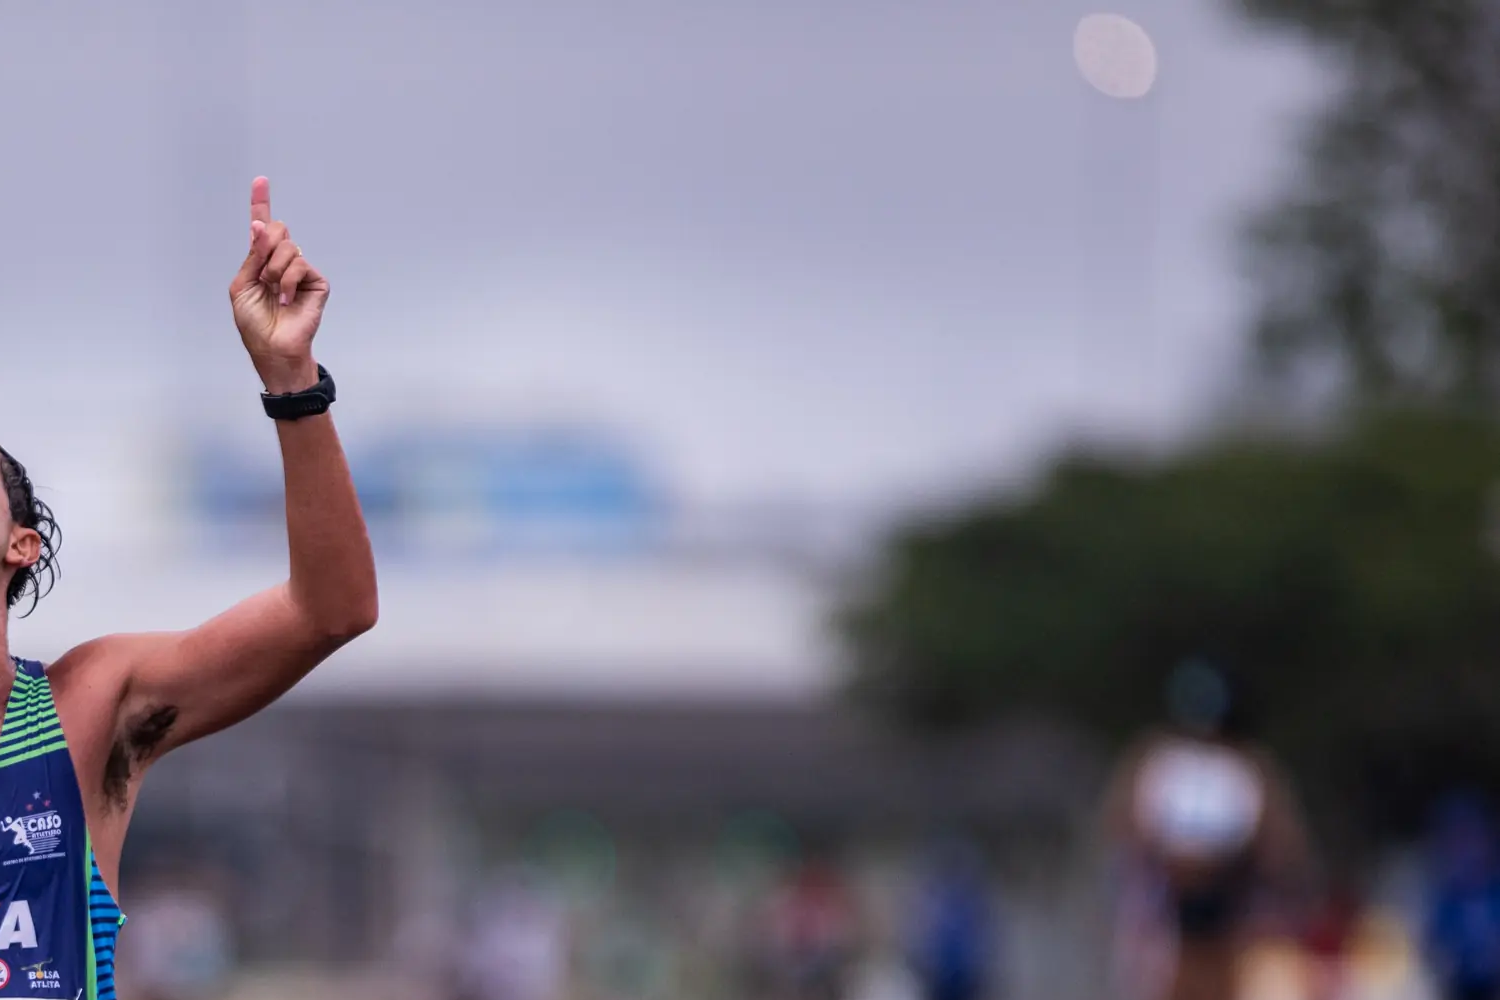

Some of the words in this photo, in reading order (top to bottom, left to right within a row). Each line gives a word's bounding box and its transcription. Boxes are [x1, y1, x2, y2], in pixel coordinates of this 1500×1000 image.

[27, 814, 62, 832] CASO
[31, 829, 62, 837] ATLETISMO
[28, 970, 60, 980] BOLSA
[31, 980, 61, 989] ATLETA
